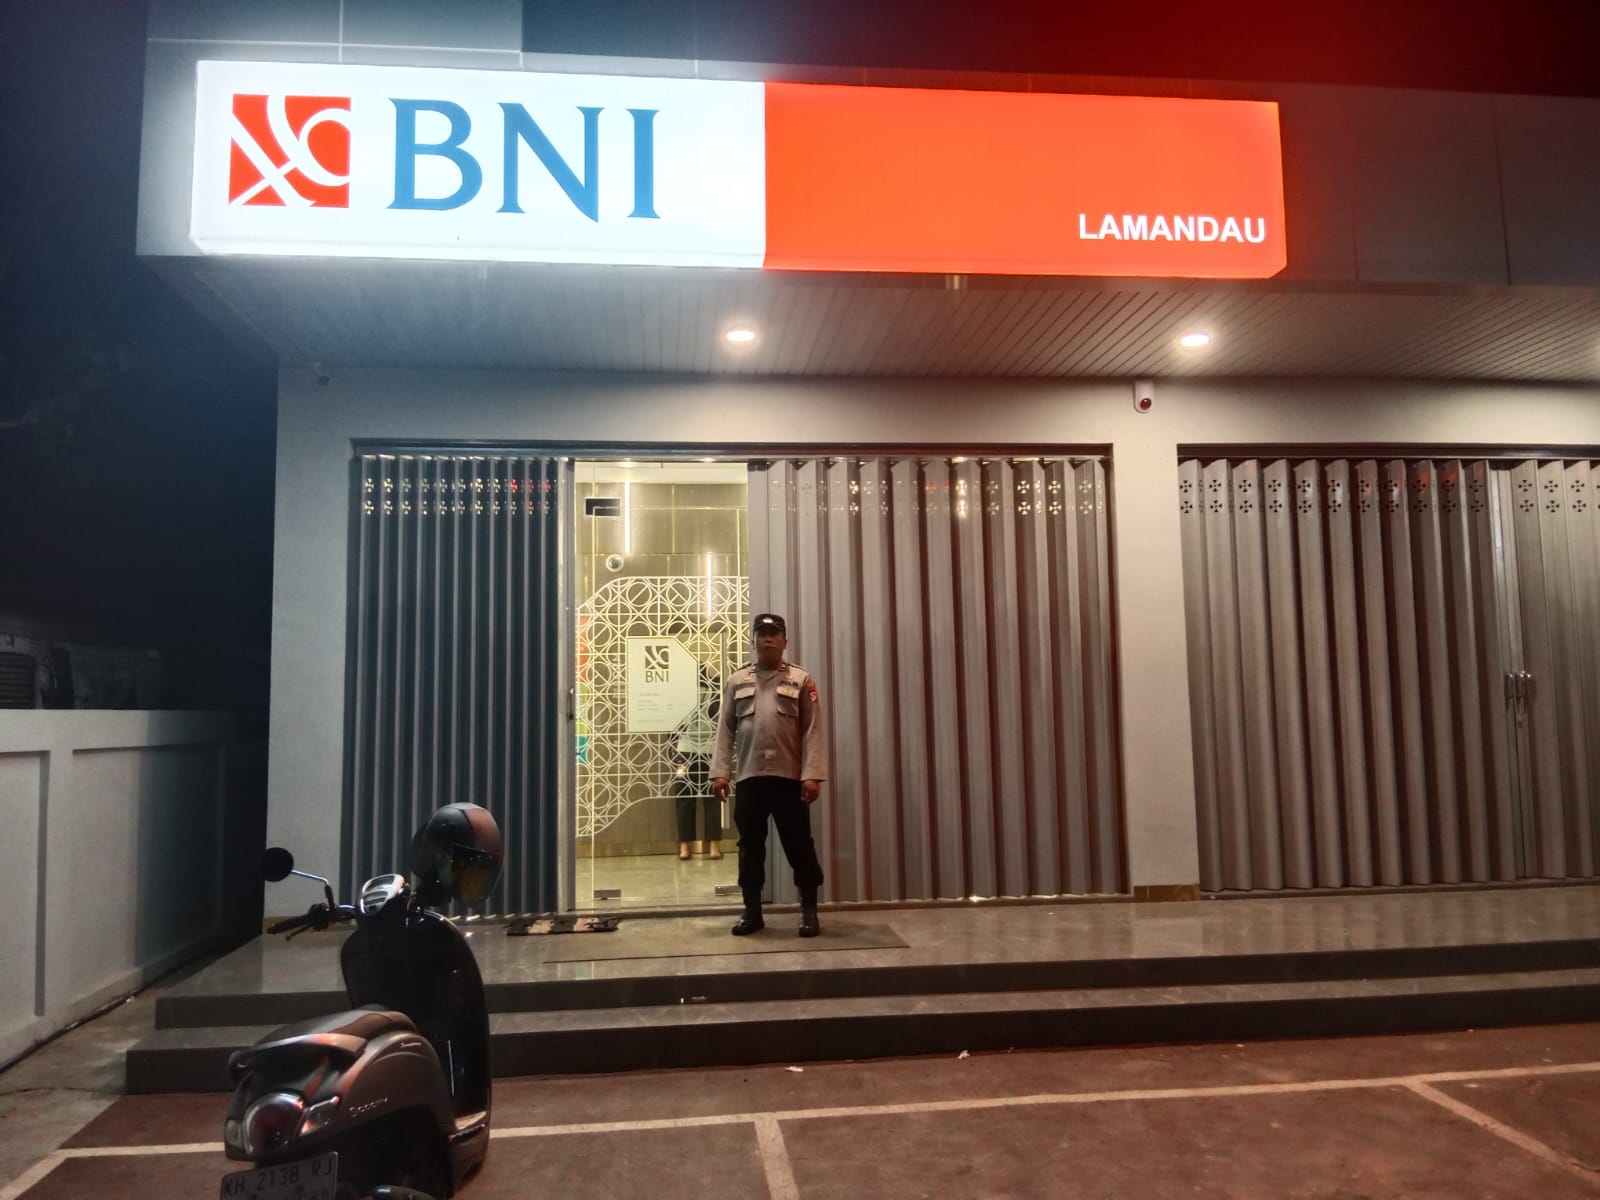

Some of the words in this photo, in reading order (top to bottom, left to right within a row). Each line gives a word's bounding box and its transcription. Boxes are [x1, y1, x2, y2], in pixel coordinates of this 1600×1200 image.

[387, 98, 661, 223] BNI
[1078, 213, 1265, 243] LAMANDAU
[645, 671, 669, 683] BNI
[224, 1175, 245, 1196] KH
[256, 1166, 299, 1191] 2138
